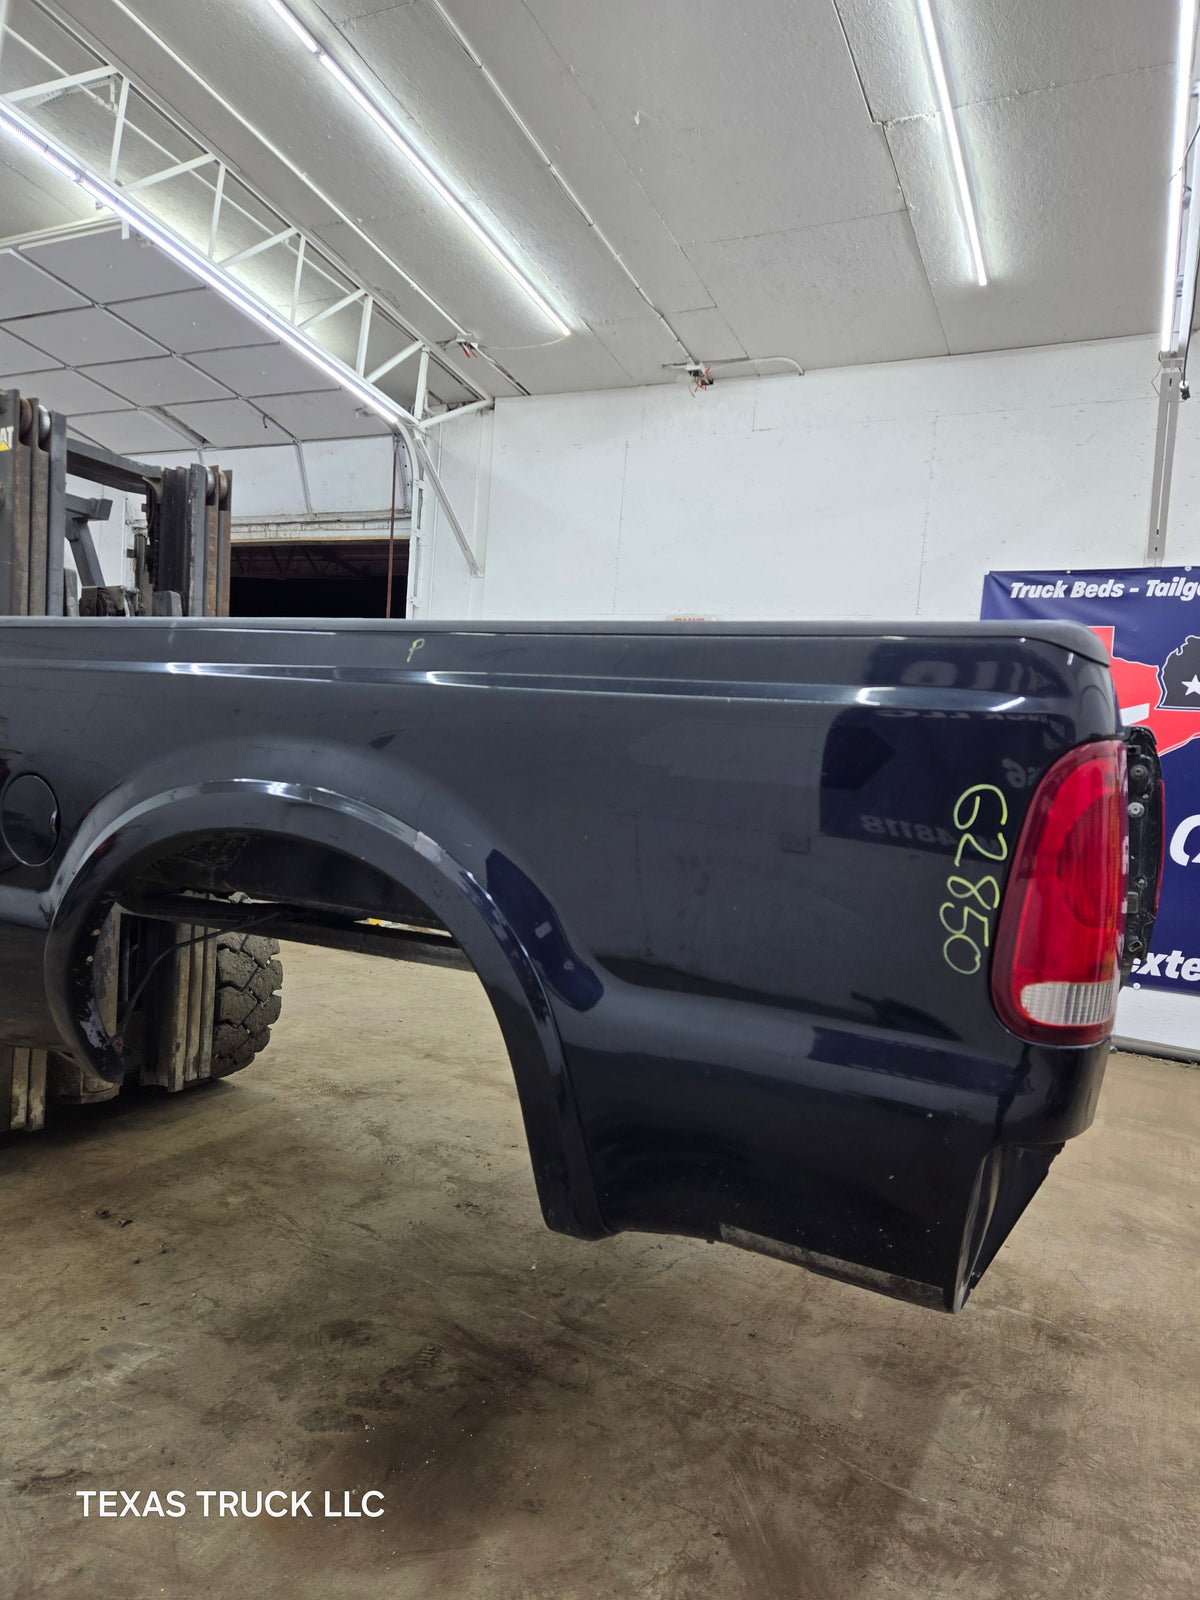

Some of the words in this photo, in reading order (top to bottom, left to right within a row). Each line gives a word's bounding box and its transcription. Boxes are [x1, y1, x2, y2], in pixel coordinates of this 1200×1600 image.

[1010, 580, 1066, 598] Truck
[1070, 579, 1125, 598] Beds
[1146, 576, 1200, 602] Tailg
[939, 784, 1008, 974] 62850
